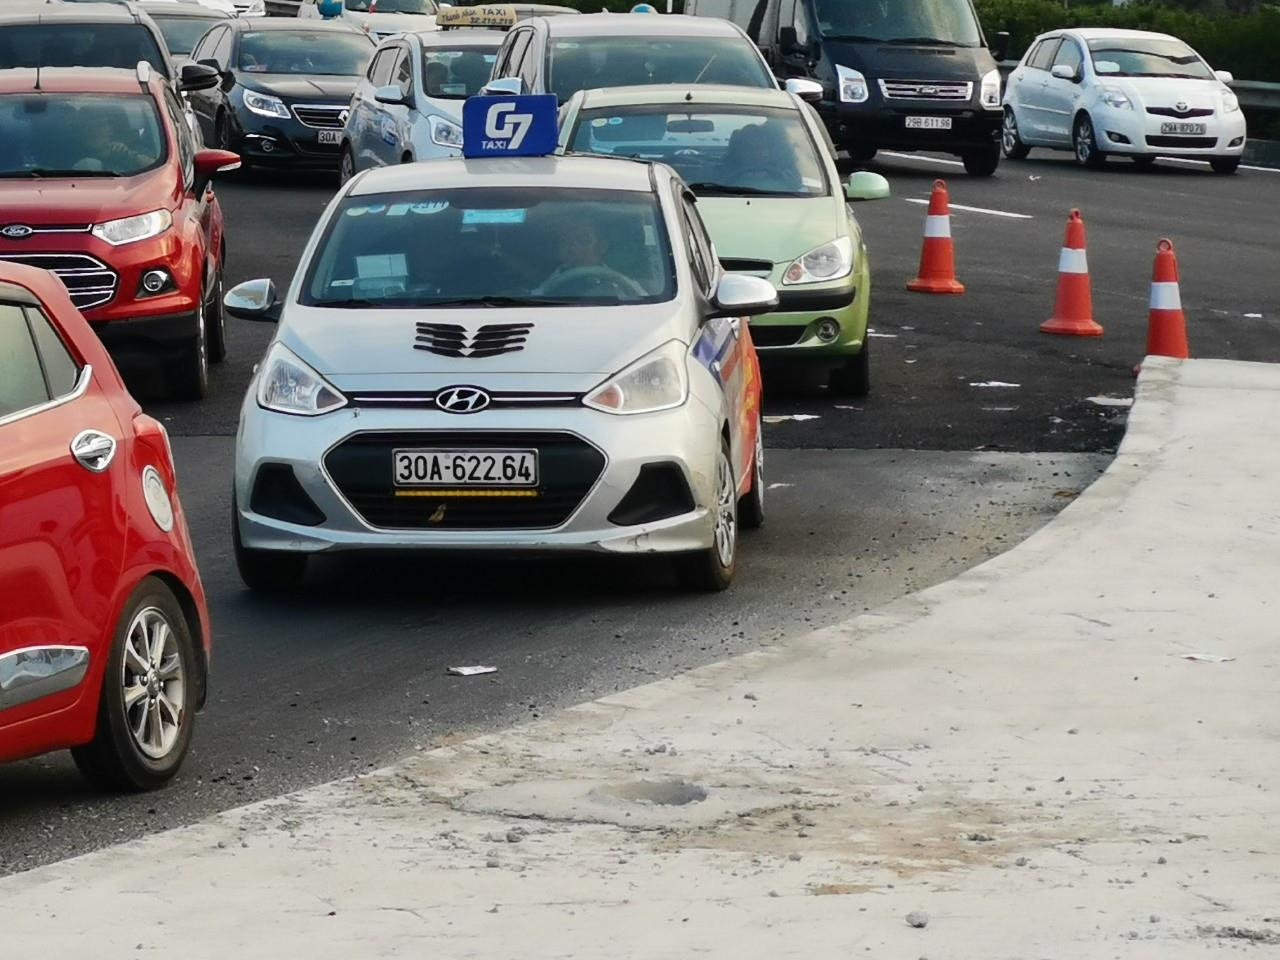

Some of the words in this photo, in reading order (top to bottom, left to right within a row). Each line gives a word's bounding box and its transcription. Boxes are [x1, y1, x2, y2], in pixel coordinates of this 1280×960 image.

[485, 102, 533, 150] G7
[480, 140, 507, 150] TAXI
[399, 455, 532, 481] 30A-622.64
